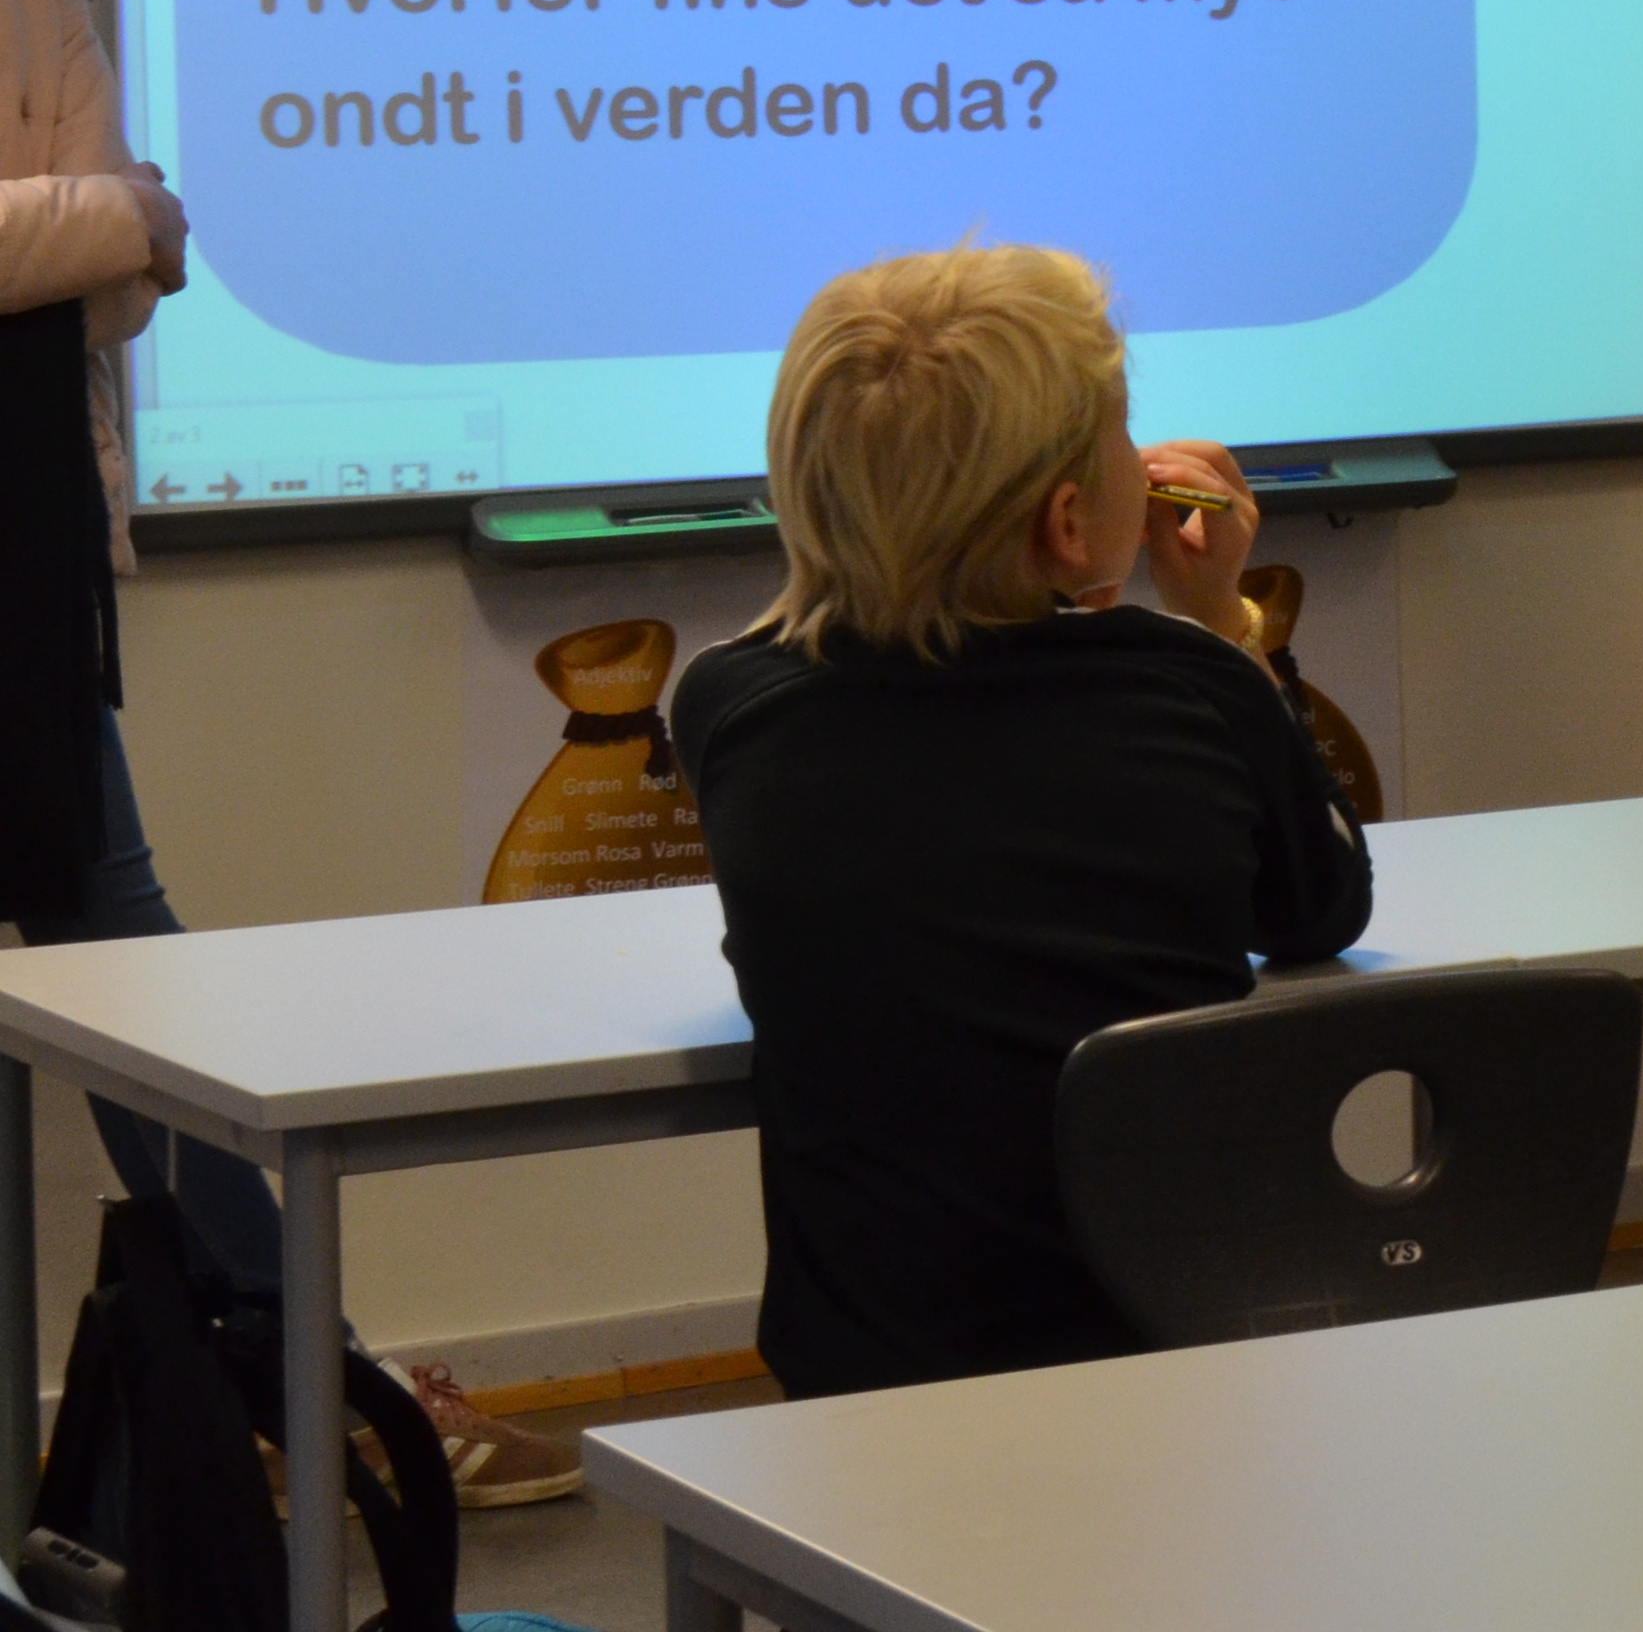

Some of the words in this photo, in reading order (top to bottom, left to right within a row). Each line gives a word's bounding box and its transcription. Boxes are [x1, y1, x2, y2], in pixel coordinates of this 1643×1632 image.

[259, 72, 479, 149] ondt
[508, 71, 522, 142] i
[557, 68, 868, 141] verden
[902, 61, 1055, 132] da?
[562, 777, 623, 796] Grønn
[639, 772, 677, 792] Rød
[585, 811, 659, 831] Slimete
[510, 847, 590, 868] Morsom
[596, 844, 642, 862] Rosa
[652, 841, 704, 859] Varm
